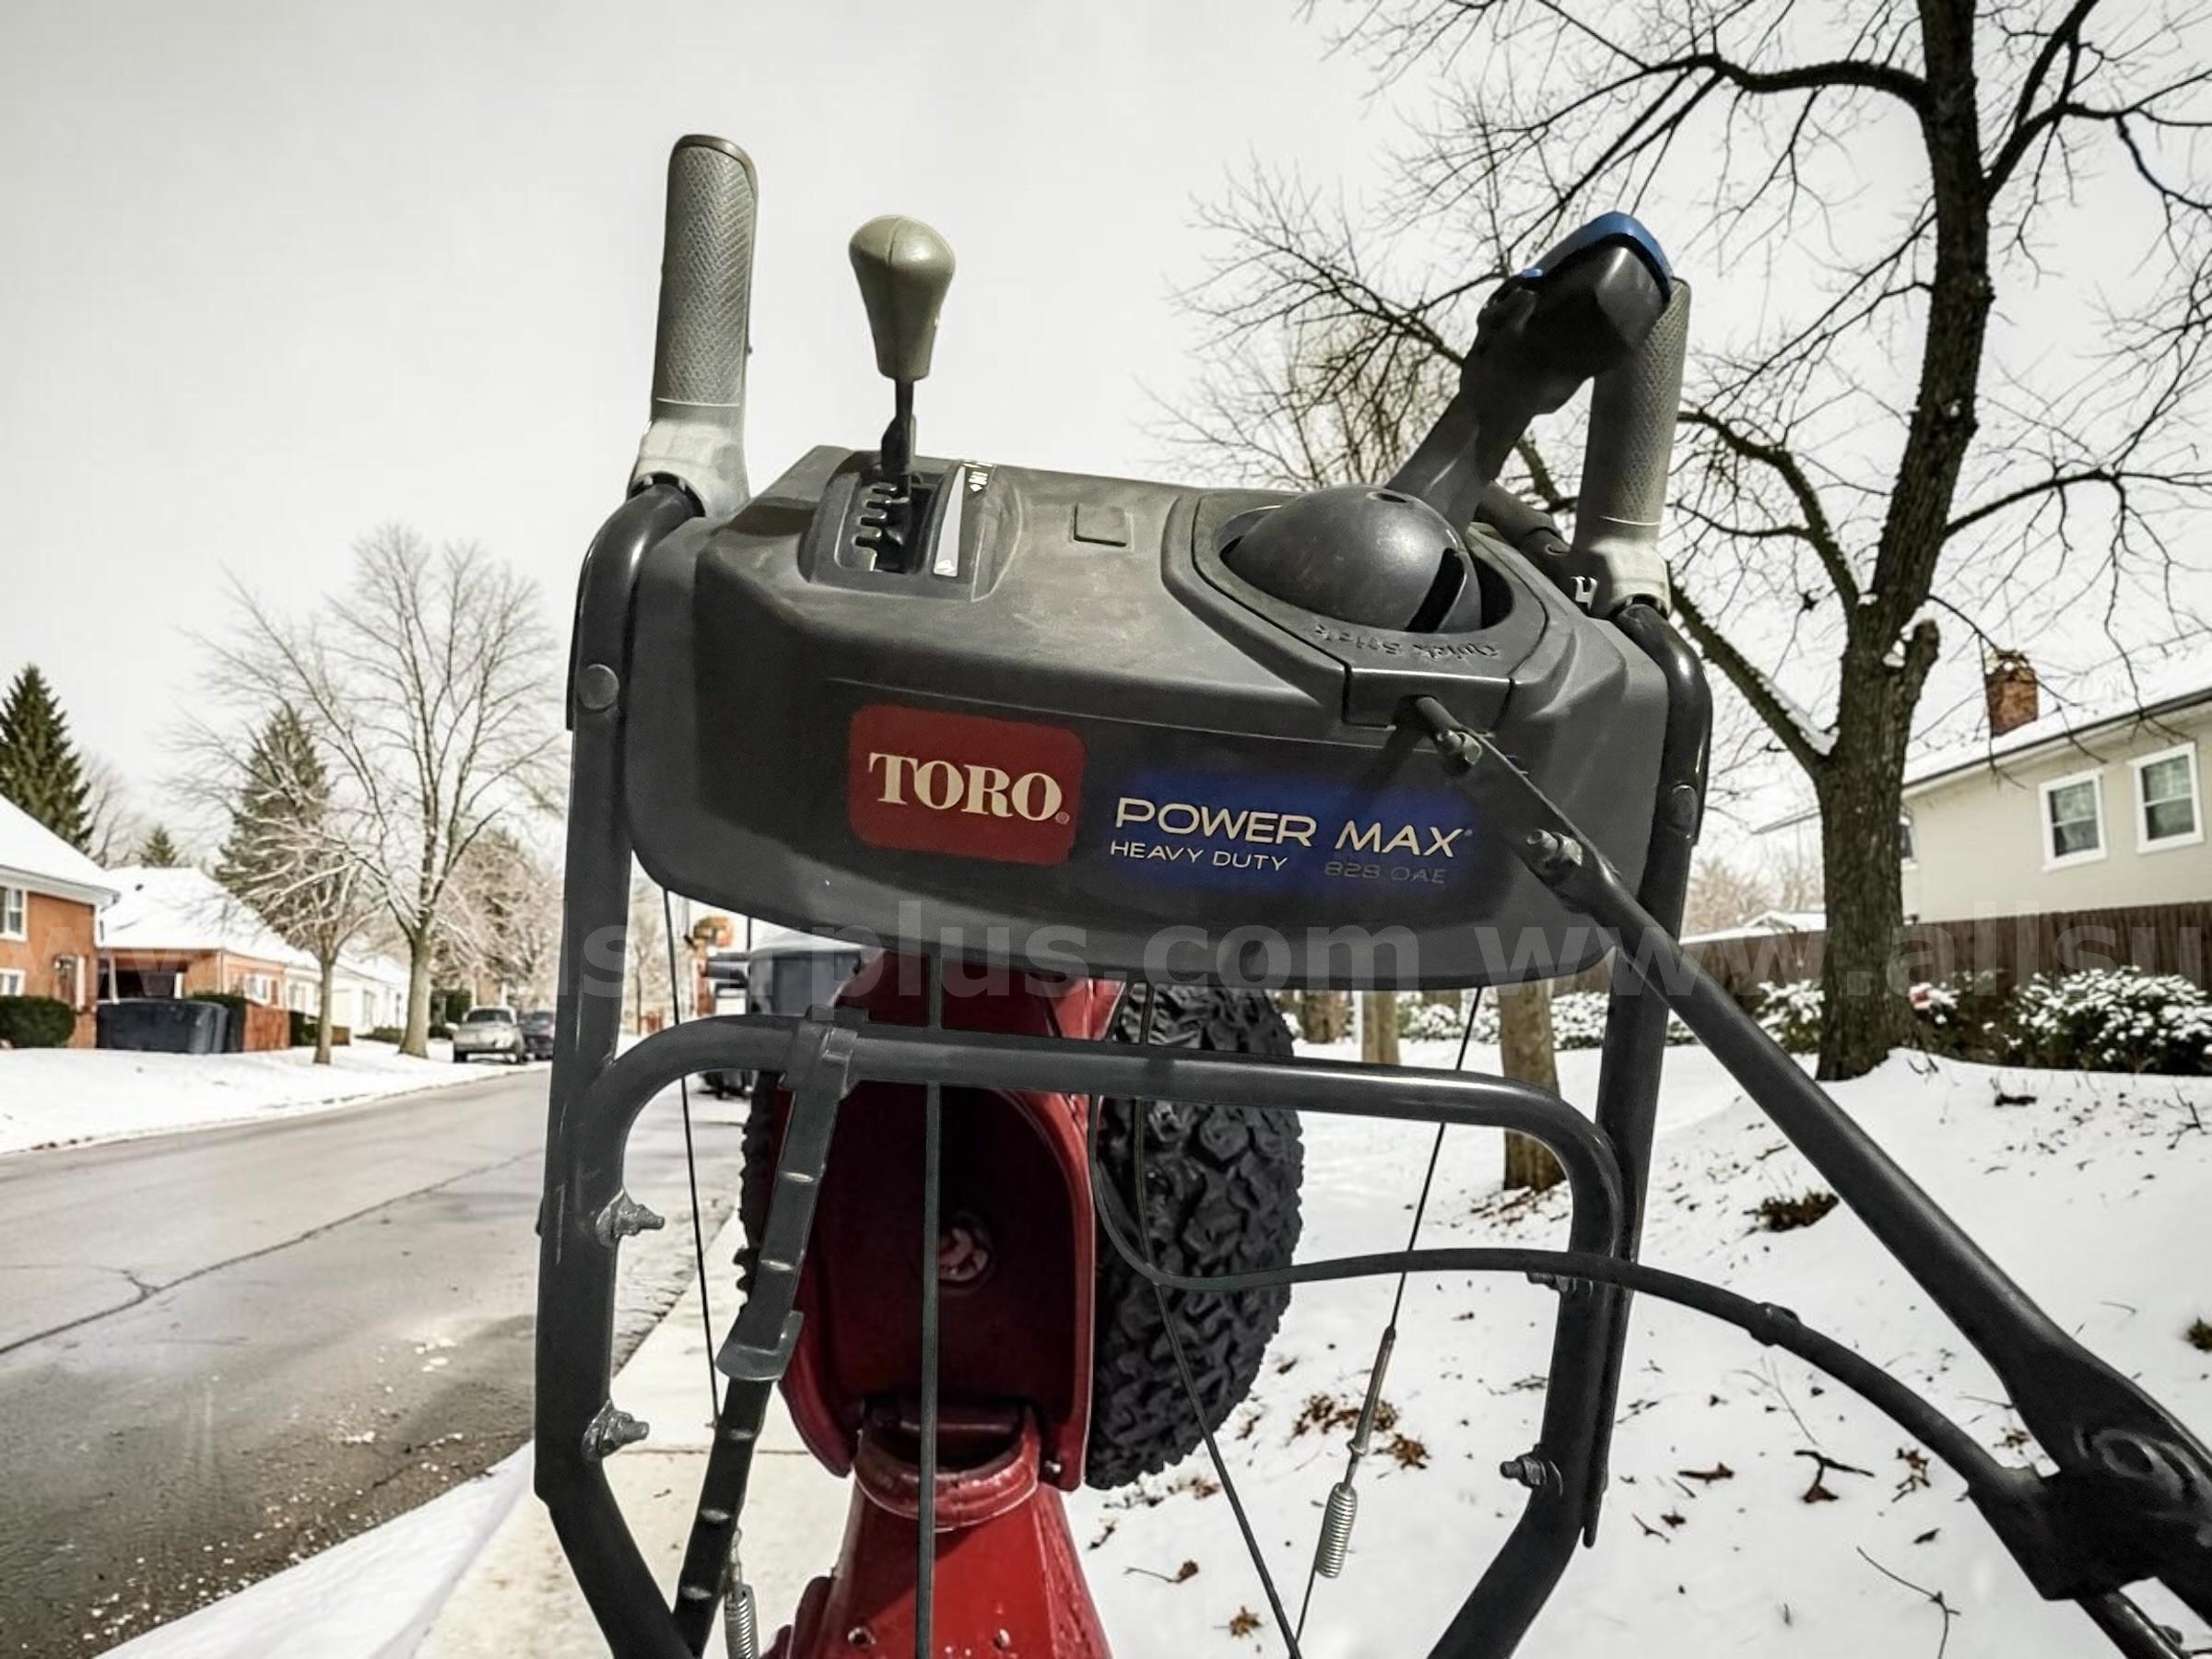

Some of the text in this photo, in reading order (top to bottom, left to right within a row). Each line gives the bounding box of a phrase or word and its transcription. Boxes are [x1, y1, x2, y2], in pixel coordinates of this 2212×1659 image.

[868, 752, 1063, 813] TORO
[1115, 797, 1464, 858] POWER MAX
[1110, 841, 1288, 871] HEAVY DUTY
[1324, 861, 1446, 885] 828 OAE
